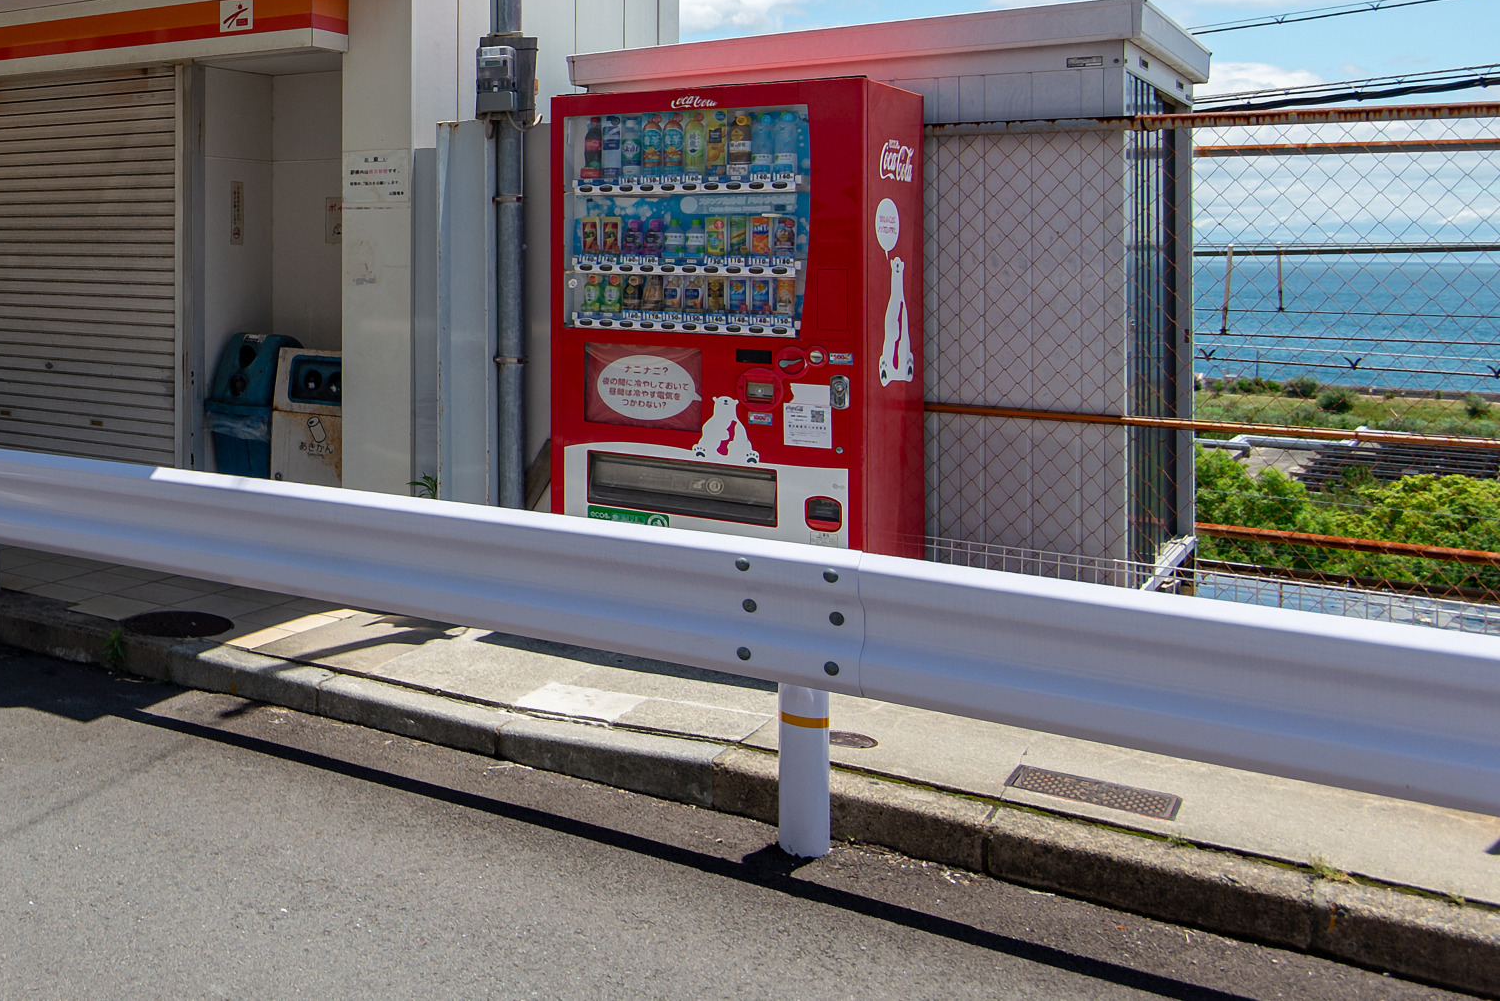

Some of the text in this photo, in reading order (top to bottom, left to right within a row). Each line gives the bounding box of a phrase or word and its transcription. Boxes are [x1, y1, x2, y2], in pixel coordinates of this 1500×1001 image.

[624, 364, 669, 376] ナニナニ?
[602, 376, 689, 391] 夜の間に冷やしておいて
[608, 387, 681, 401] 昼間は冷やす電気を
[622, 398, 667, 409] つかわない?
[299, 441, 334, 455] あきかん
